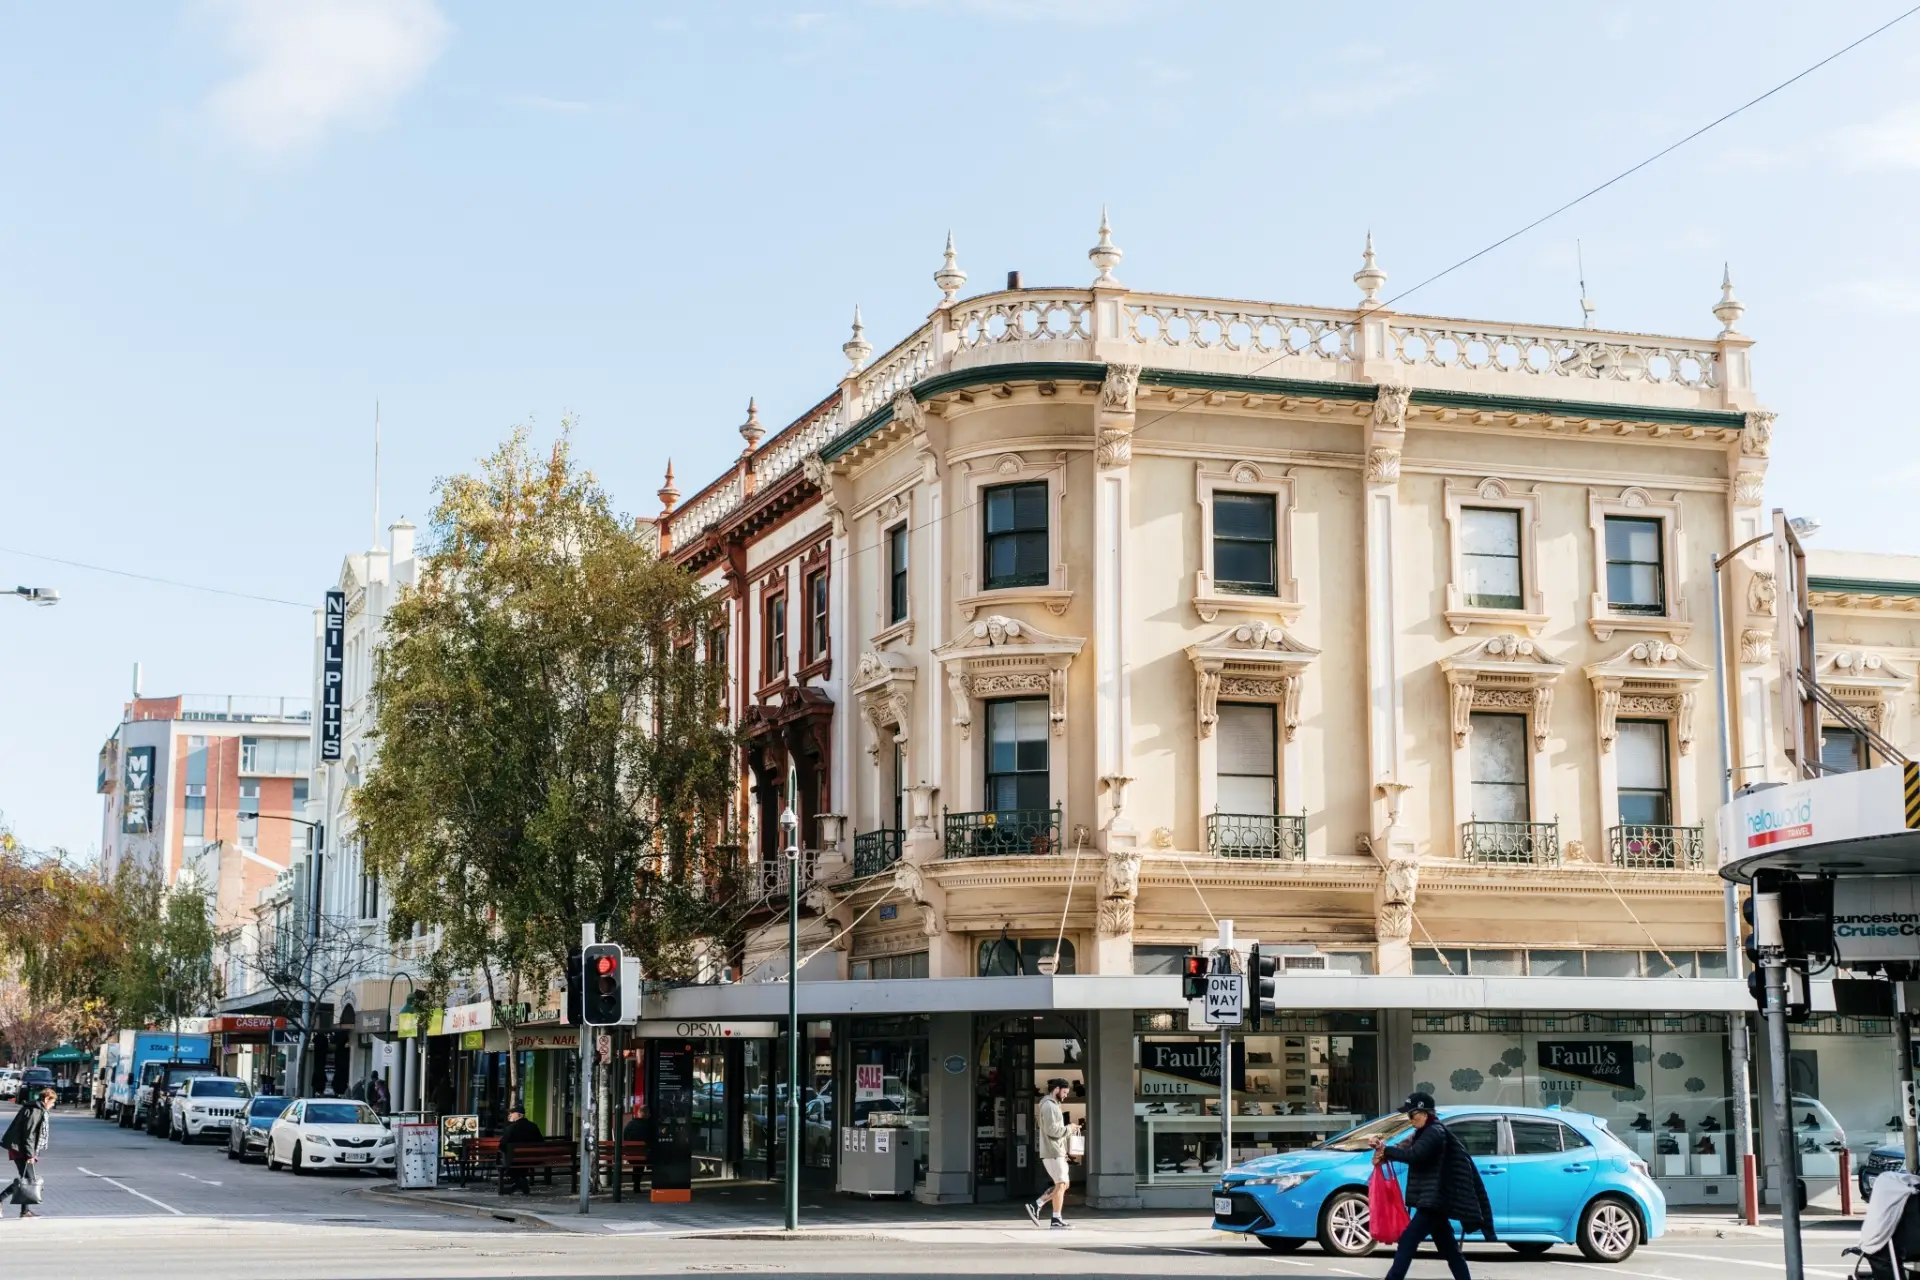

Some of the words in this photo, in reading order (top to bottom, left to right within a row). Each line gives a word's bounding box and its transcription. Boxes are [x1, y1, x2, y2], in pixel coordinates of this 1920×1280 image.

[327, 597, 343, 662] NEIL
[323, 671, 341, 756] PITT'S
[127, 755, 148, 824] MYER
[1788, 826, 1810, 838] TRAVEL
[1211, 979, 1237, 991] ONE
[1209, 994, 1238, 1006] WAY
[236, 1018, 278, 1028] CASEWAY
[676, 1022, 722, 1037] OPSM
[283, 1031, 299, 1043] Ne
[517, 1035, 544, 1048] ally's
[552, 1035, 577, 1046] NAIL
[149, 1044, 193, 1053] STARTACK
[1549, 1045, 1616, 1065] Faull's
[1592, 1059, 1621, 1075] shoes
[858, 1066, 881, 1089] SALE
[1144, 1083, 1189, 1094] OUTLET
[1541, 1081, 1583, 1091] OUTLET
